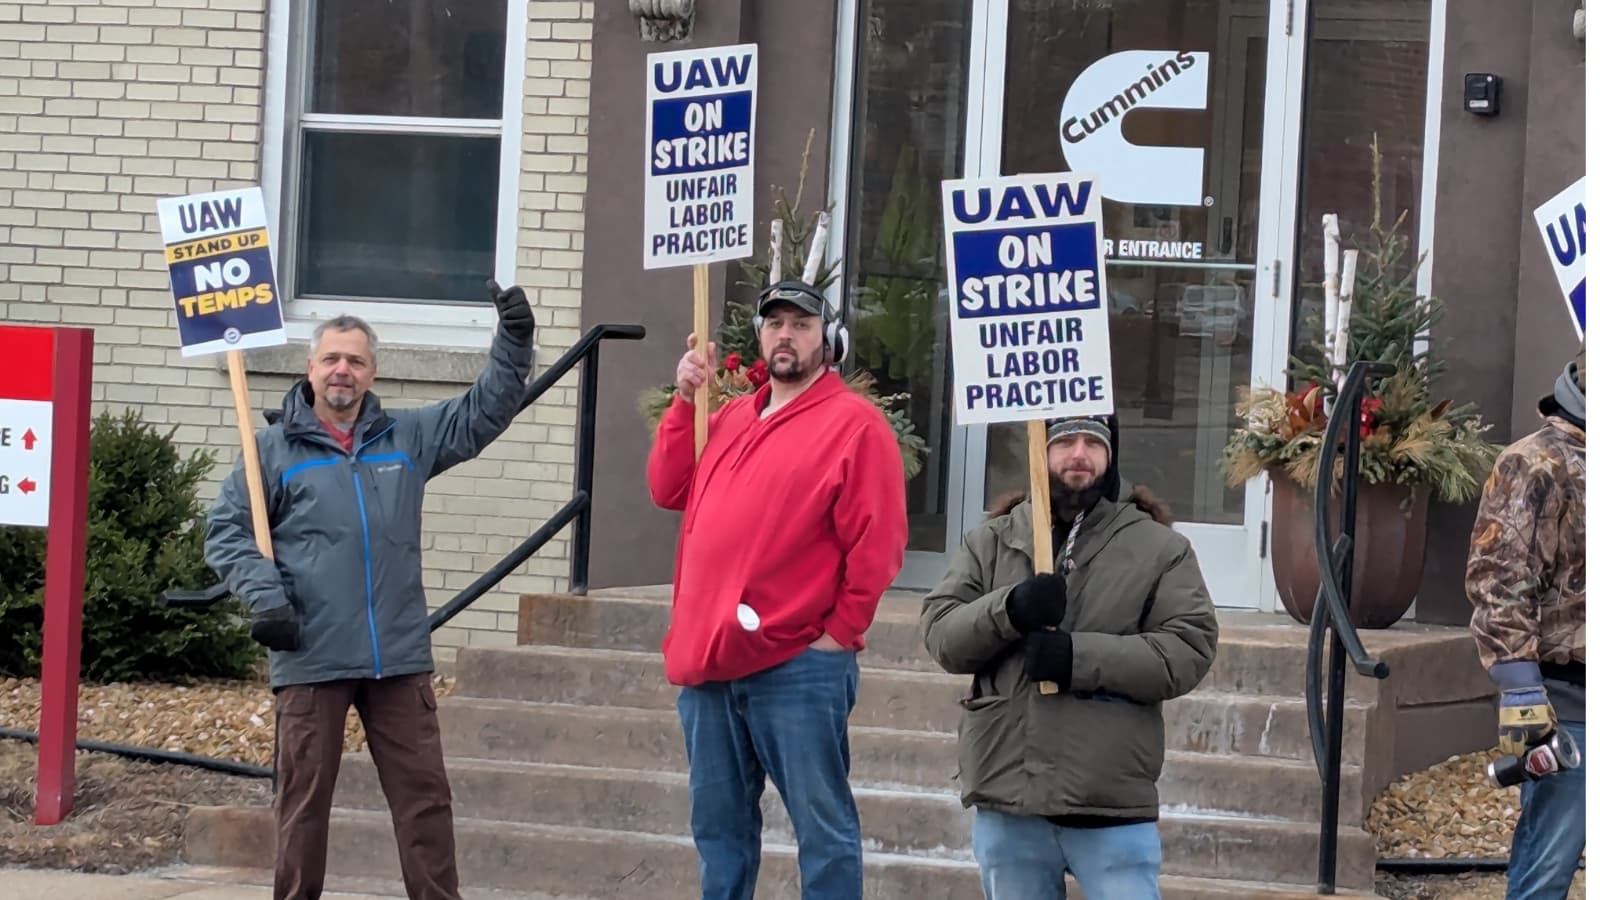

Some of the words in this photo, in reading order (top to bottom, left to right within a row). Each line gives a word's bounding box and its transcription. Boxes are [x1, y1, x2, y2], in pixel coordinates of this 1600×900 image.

[654, 54, 752, 93] UAW
[1062, 50, 1196, 144] Cummins
[684, 99, 723, 132] ON
[654, 131, 748, 169] STRIKE
[666, 173, 737, 203] UNFAIR
[952, 180, 1093, 224] UAW
[178, 197, 243, 234] UAW
[669, 200, 734, 228] LABOR
[173, 238, 232, 260] STAND
[238, 233, 261, 247] UP
[652, 224, 748, 256] PRACTICE
[998, 232, 1052, 269] ON
[1118, 239, 1202, 259] ENTRANCE
[193, 257, 250, 292] NO
[960, 269, 1096, 311] STRIKE
[178, 283, 273, 318] TEMPS
[979, 317, 1083, 349] UNFAIR
[986, 348, 1080, 379] LABOR
[965, 376, 1105, 410] PRACTICE
